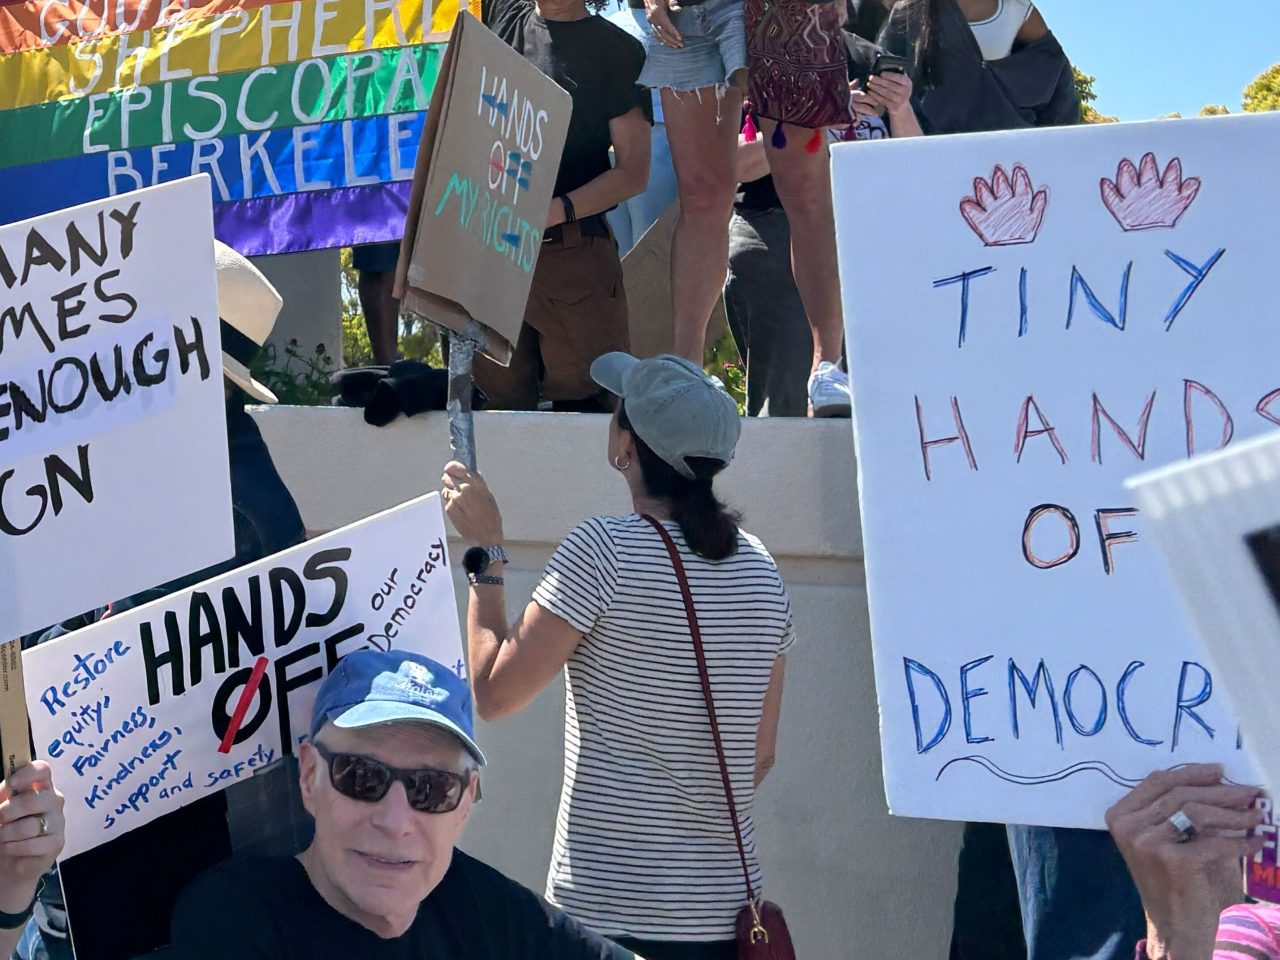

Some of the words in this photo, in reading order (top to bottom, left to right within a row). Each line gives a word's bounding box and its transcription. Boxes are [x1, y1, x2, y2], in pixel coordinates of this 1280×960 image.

[83, 43, 448, 154] EPISCOPA
[477, 66, 549, 161] HANDS
[487, 140, 533, 206] OFF
[434, 170, 480, 228] MY
[481, 191, 541, 274] RIGHTS
[932, 248, 1226, 348] TINY
[139, 546, 352, 706] HANDS
[366, 537, 447, 653] Democracy
[370, 568, 399, 612] our
[39, 640, 131, 716] Restore
[903, 654, 1243, 755] DEMOCR
[103, 749, 183, 830] support
[158, 771, 194, 800] and
